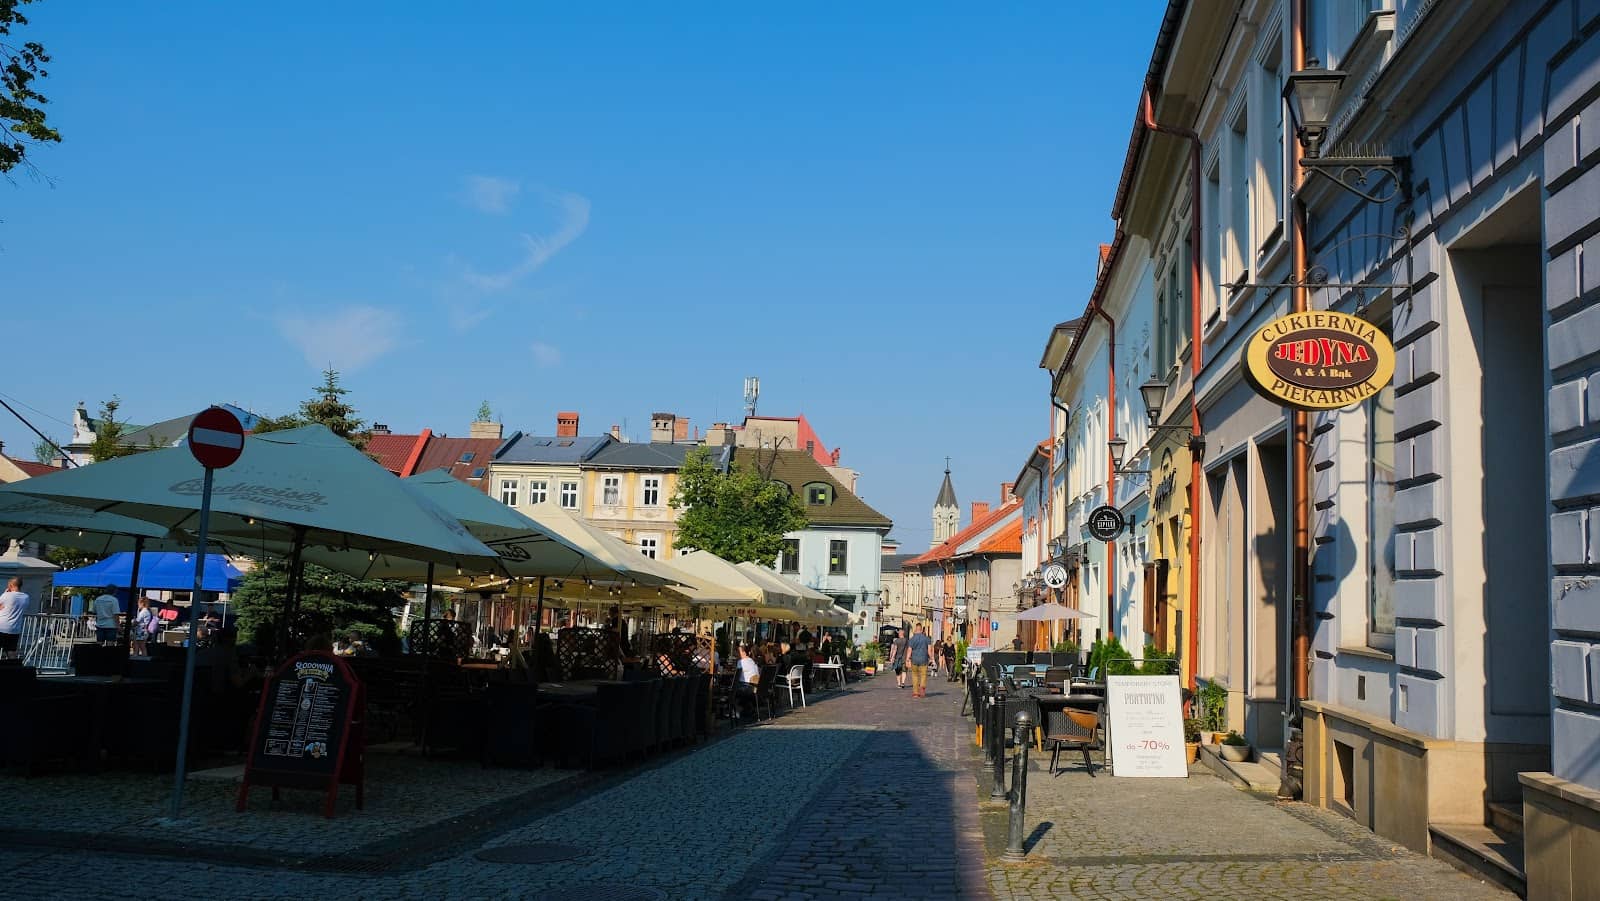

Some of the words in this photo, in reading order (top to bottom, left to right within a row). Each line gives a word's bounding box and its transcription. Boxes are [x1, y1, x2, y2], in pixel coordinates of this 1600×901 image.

[1262, 314, 1376, 344] CUKIERNIA
[1274, 337, 1371, 368] JEDYNA
[1293, 367, 1302, 377] A
[1305, 367, 1316, 377] &
[1318, 368, 1327, 377] A
[1271, 379, 1378, 404] PIEKARNIA
[295, 661, 335, 674] SŁODOWNIA
